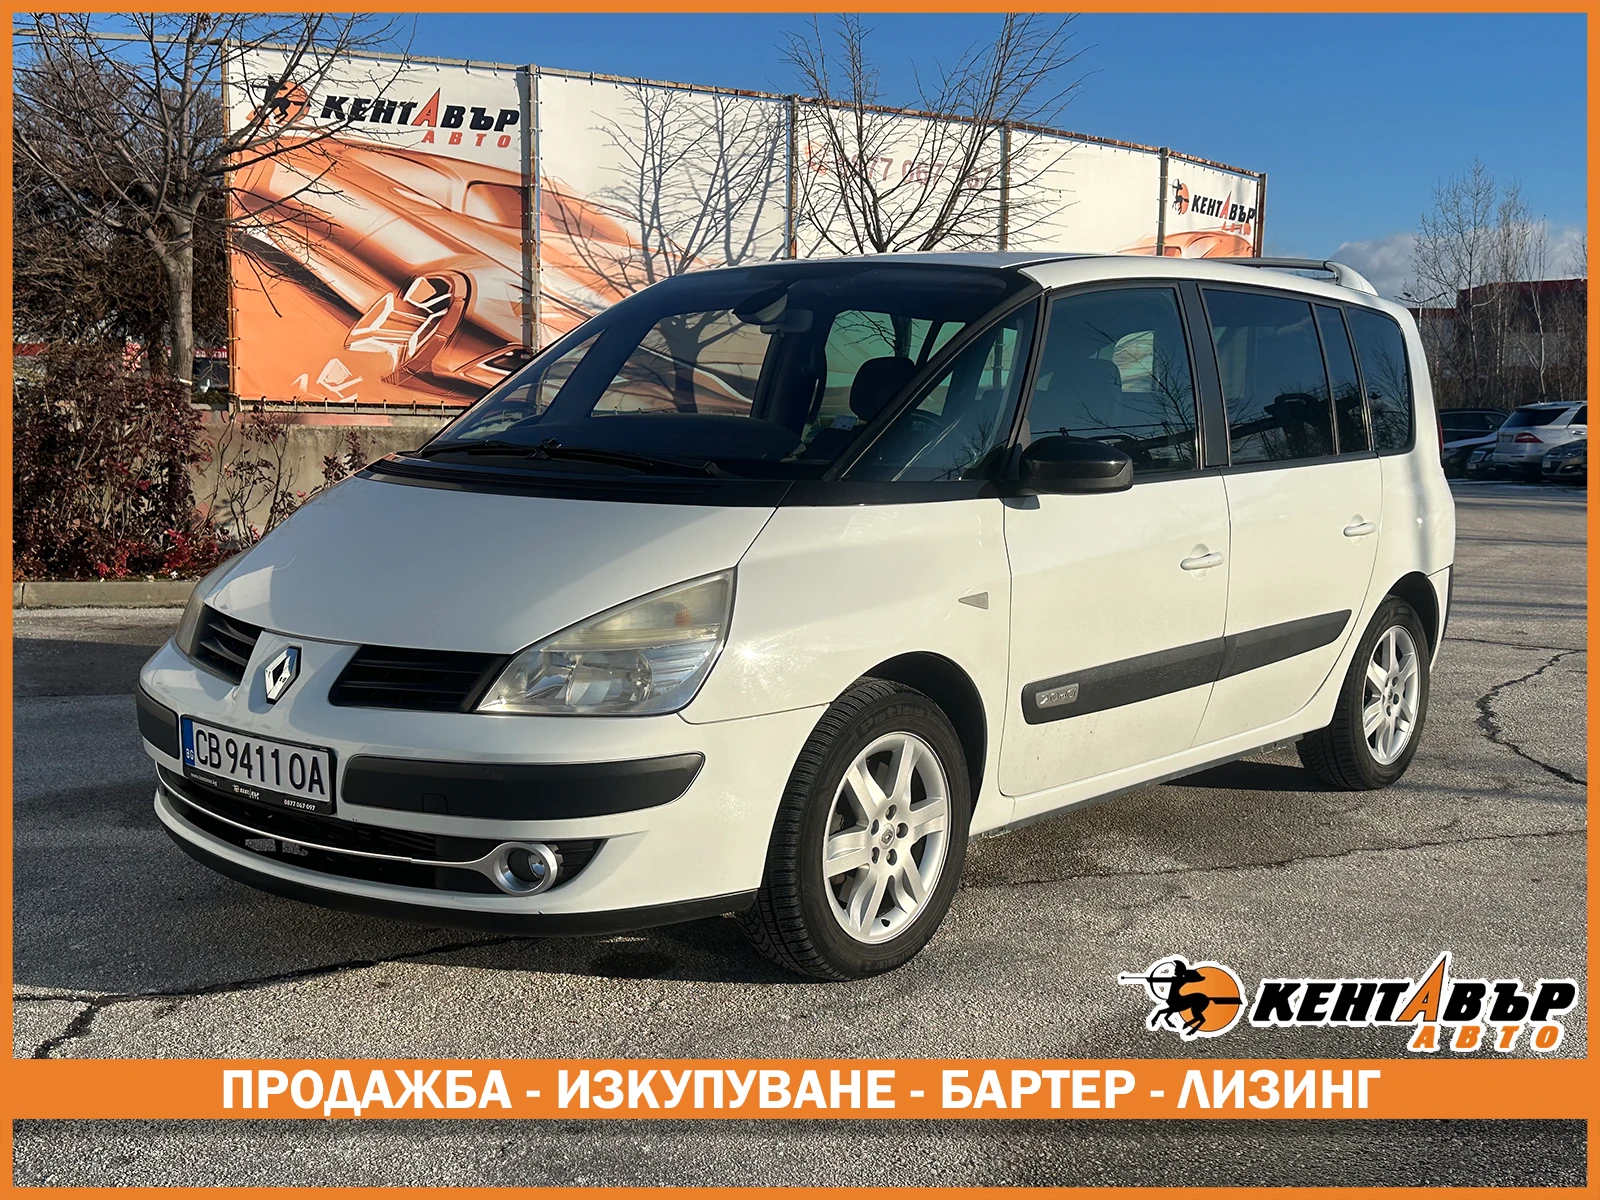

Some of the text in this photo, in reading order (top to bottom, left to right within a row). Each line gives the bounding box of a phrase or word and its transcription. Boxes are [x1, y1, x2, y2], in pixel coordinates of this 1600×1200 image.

[320, 87, 520, 131] КЕНТАВЪР
[421, 130, 512, 148] АВТО
[1191, 190, 1256, 223] КЕНТАВЪР
